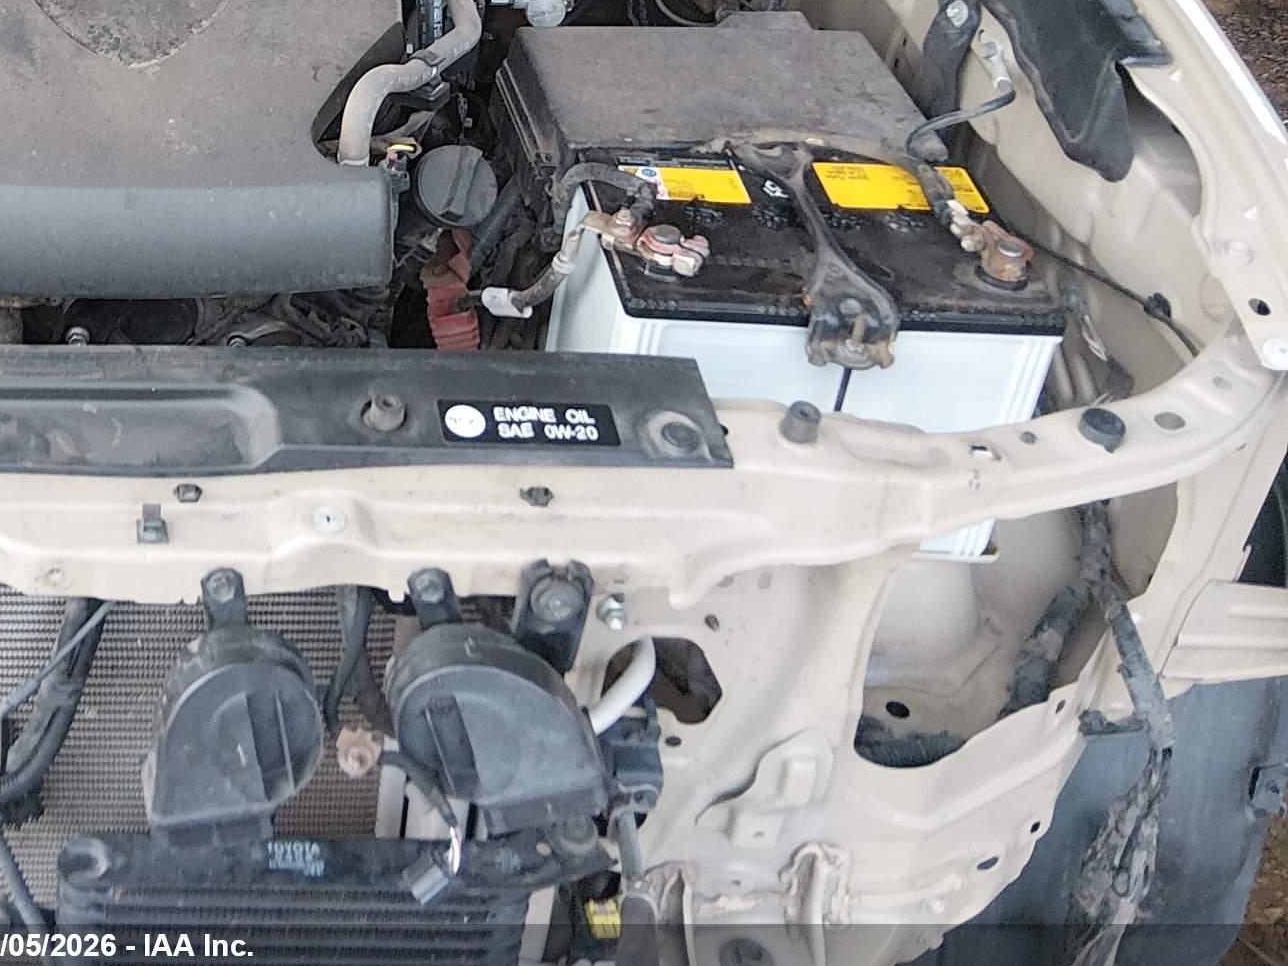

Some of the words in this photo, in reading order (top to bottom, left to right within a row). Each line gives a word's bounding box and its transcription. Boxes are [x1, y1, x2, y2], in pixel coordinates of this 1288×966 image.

[493, 406, 557, 423] ENGINE
[565, 408, 596, 424] OIL
[497, 422, 535, 438] SAE
[544, 425, 598, 441] 0W-20
